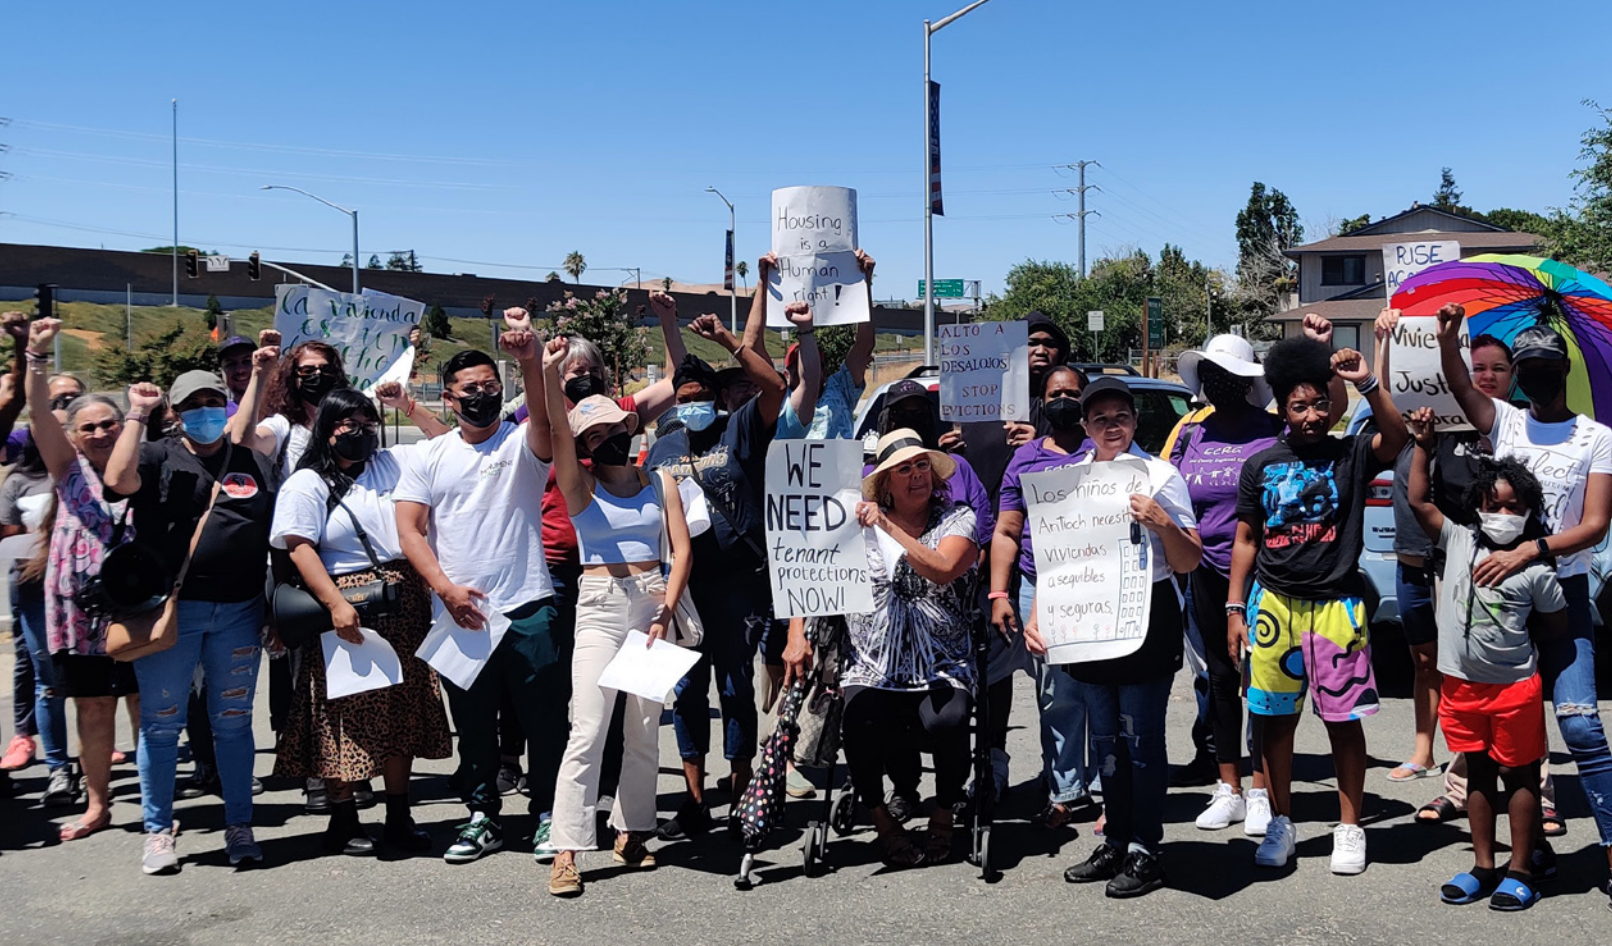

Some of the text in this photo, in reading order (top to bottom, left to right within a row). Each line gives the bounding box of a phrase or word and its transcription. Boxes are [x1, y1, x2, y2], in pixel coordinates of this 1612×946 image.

[777, 205, 842, 236] Housing
[800, 237, 829, 250] is a
[1396, 245, 1443, 266] RISE
[780, 258, 840, 279] Human
[301, 318, 409, 353] es un
[941, 324, 1005, 339] ALTO A
[1391, 323, 1470, 350] Viviea
[282, 335, 392, 372] dcho
[941, 344, 970, 357] LOS
[941, 357, 1007, 373] DESALOJOS
[962, 384, 998, 398] STOP
[1396, 371, 1448, 396] Just
[942, 404, 1016, 417] EVICTIONS
[785, 443, 825, 488] WE
[1031, 474, 1143, 504] Los niños de
[767, 493, 847, 532] NEED
[773, 537, 841, 565] tenant
[777, 566, 867, 591] protections
[1047, 566, 1106, 589] asequibles
[787, 586, 846, 617] NOW!
[1047, 604, 1055, 627] y
